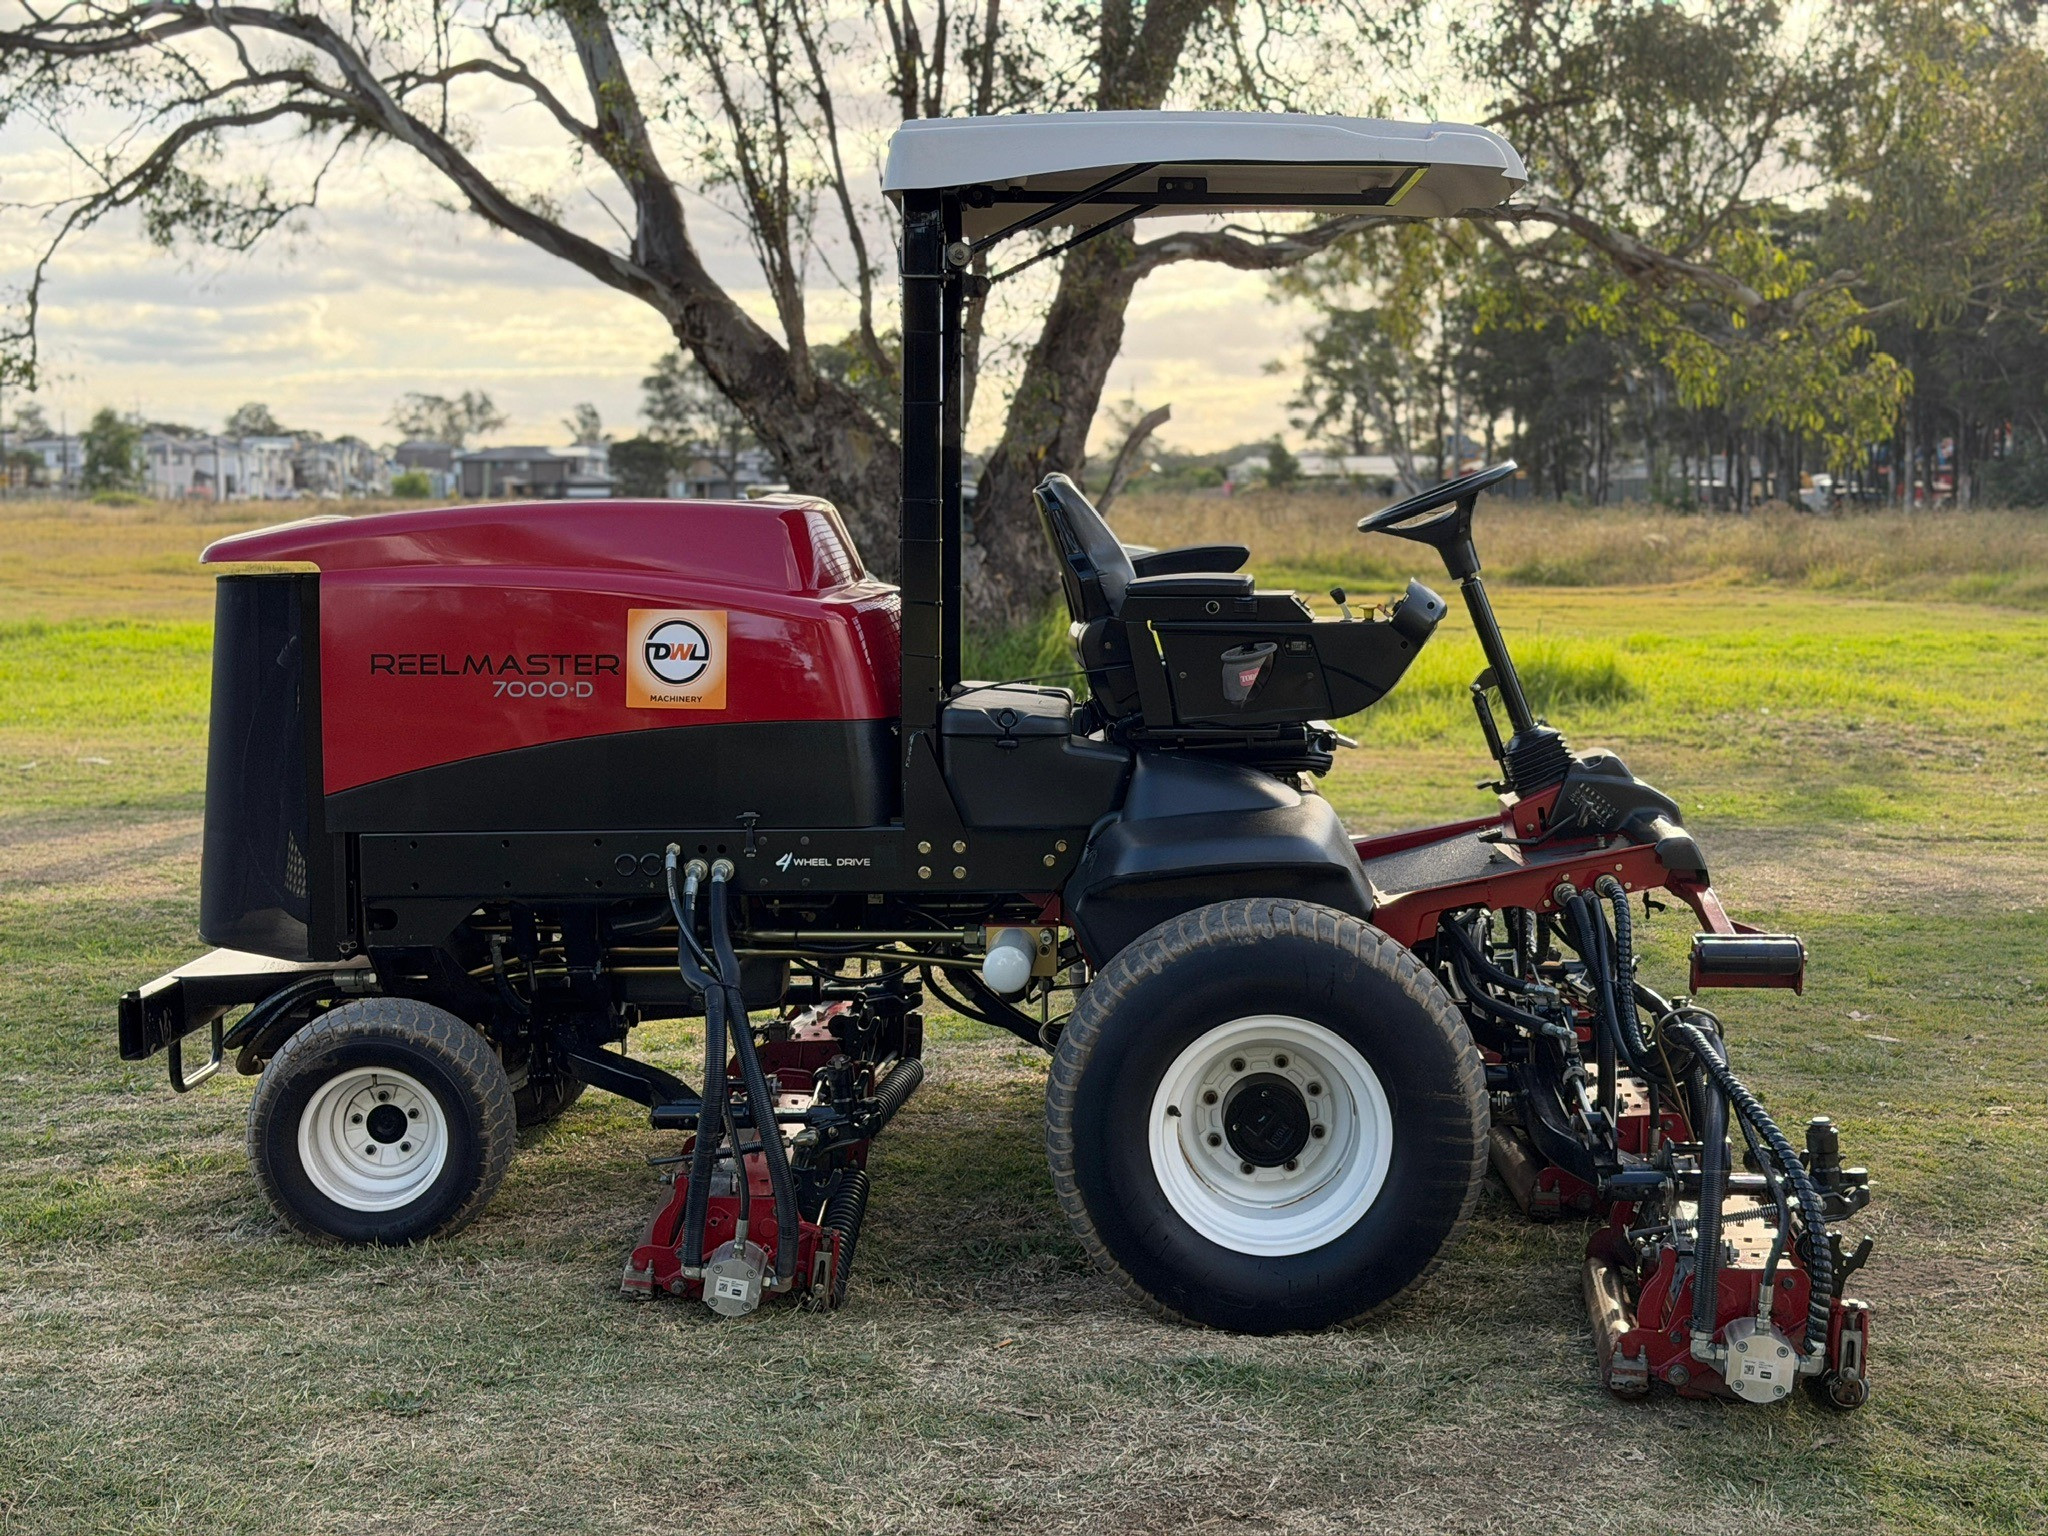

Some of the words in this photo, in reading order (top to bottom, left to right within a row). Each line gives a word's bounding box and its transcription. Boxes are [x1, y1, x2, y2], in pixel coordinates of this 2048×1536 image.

[646, 643, 709, 660] DWL
[370, 654, 620, 676] REELMASTER
[649, 694, 703, 703] MACHINERY
[775, 851, 793, 872] 4
[793, 858, 832, 867] WHEEL
[836, 858, 871, 867] DRIVE
